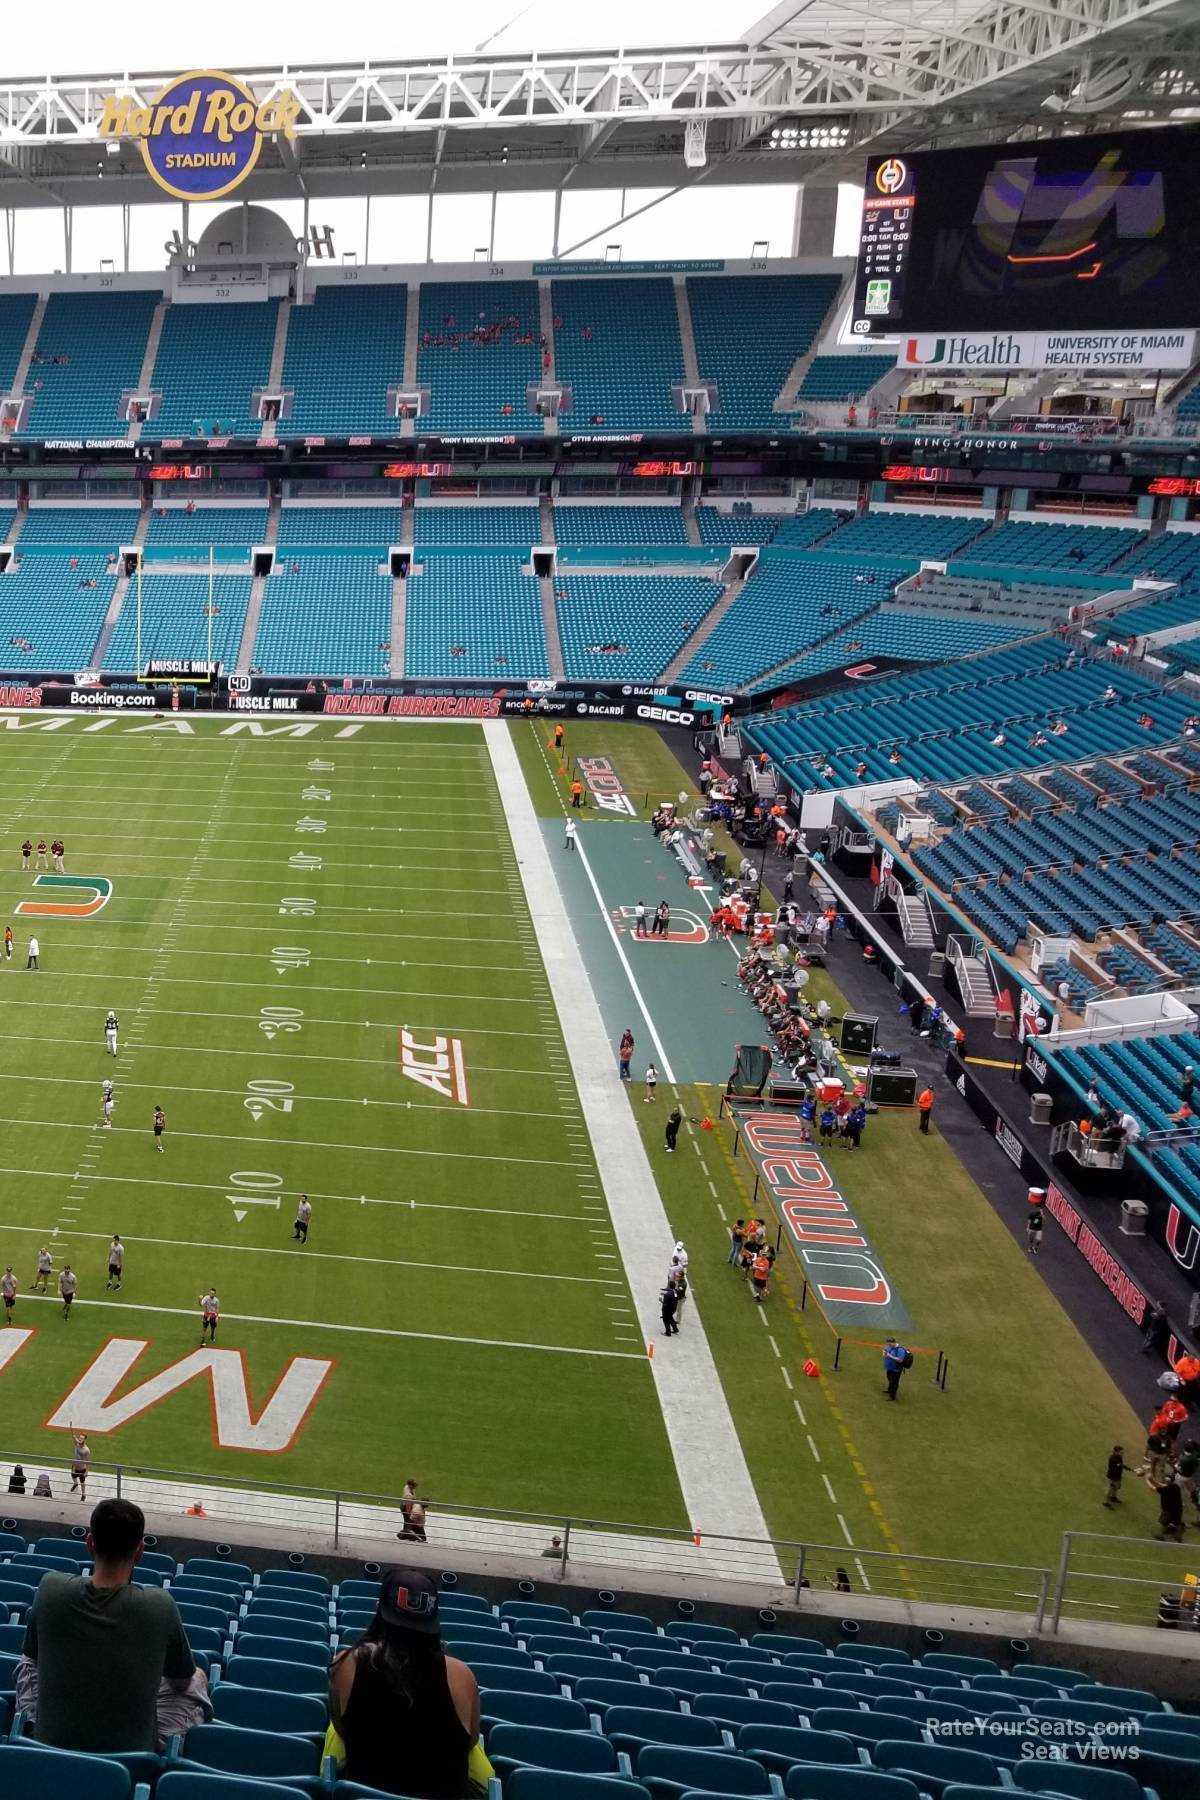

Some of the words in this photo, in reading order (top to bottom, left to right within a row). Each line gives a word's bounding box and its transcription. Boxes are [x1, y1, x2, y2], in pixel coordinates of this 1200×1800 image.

[100, 90, 202, 138] Hard
[203, 88, 301, 142] Rock
[165, 152, 236, 168] STADIUM
[893, 233, 909, 241] 0:00
[866, 255, 871, 263] 0
[855, 322, 869, 331] CC
[1047, 337, 1119, 350] UNIVERSITY
[1121, 337, 1139, 349] OF
[1141, 336, 1185, 349] MIAMI
[1045, 352, 1088, 365] HEALTH
[1094, 352, 1143, 364] SYSTEM
[45, 440, 84, 448] NATIONAL
[85, 440, 136, 448] CHAMPIONS
[914, 438, 950, 447] RING
[964, 440, 1018, 449] HONOR
[151, 661, 190, 673] MUSCLE
[192, 661, 216, 673] MILK
[232, 678, 248, 689] 40
[70, 691, 156, 708] Booking.com
[275, 697, 298, 709] MILK
[323, 695, 387, 713] MIAMI
[389, 696, 501, 716] HURRICANES
[685, 690, 734, 705] GEICO
[637, 705, 695, 726] GEICO
[306, 760, 335, 772] 10
[301, 788, 331, 801] 20
[295, 818, 327, 834] 30
[288, 855, 323, 871] 40
[279, 896, 317, 915] 50
[269, 947, 311, 968] 40
[258, 1007, 304, 1032] 30
[401, 1029, 452, 1098] ACC
[243, 1079, 295, 1113] 20
[225, 1171, 284, 1209] 10
[1045, 1181, 1081, 1243] MIAMI
[1077, 1222, 1147, 1326] HURRICANES
[397, 1587, 430, 1614] U
